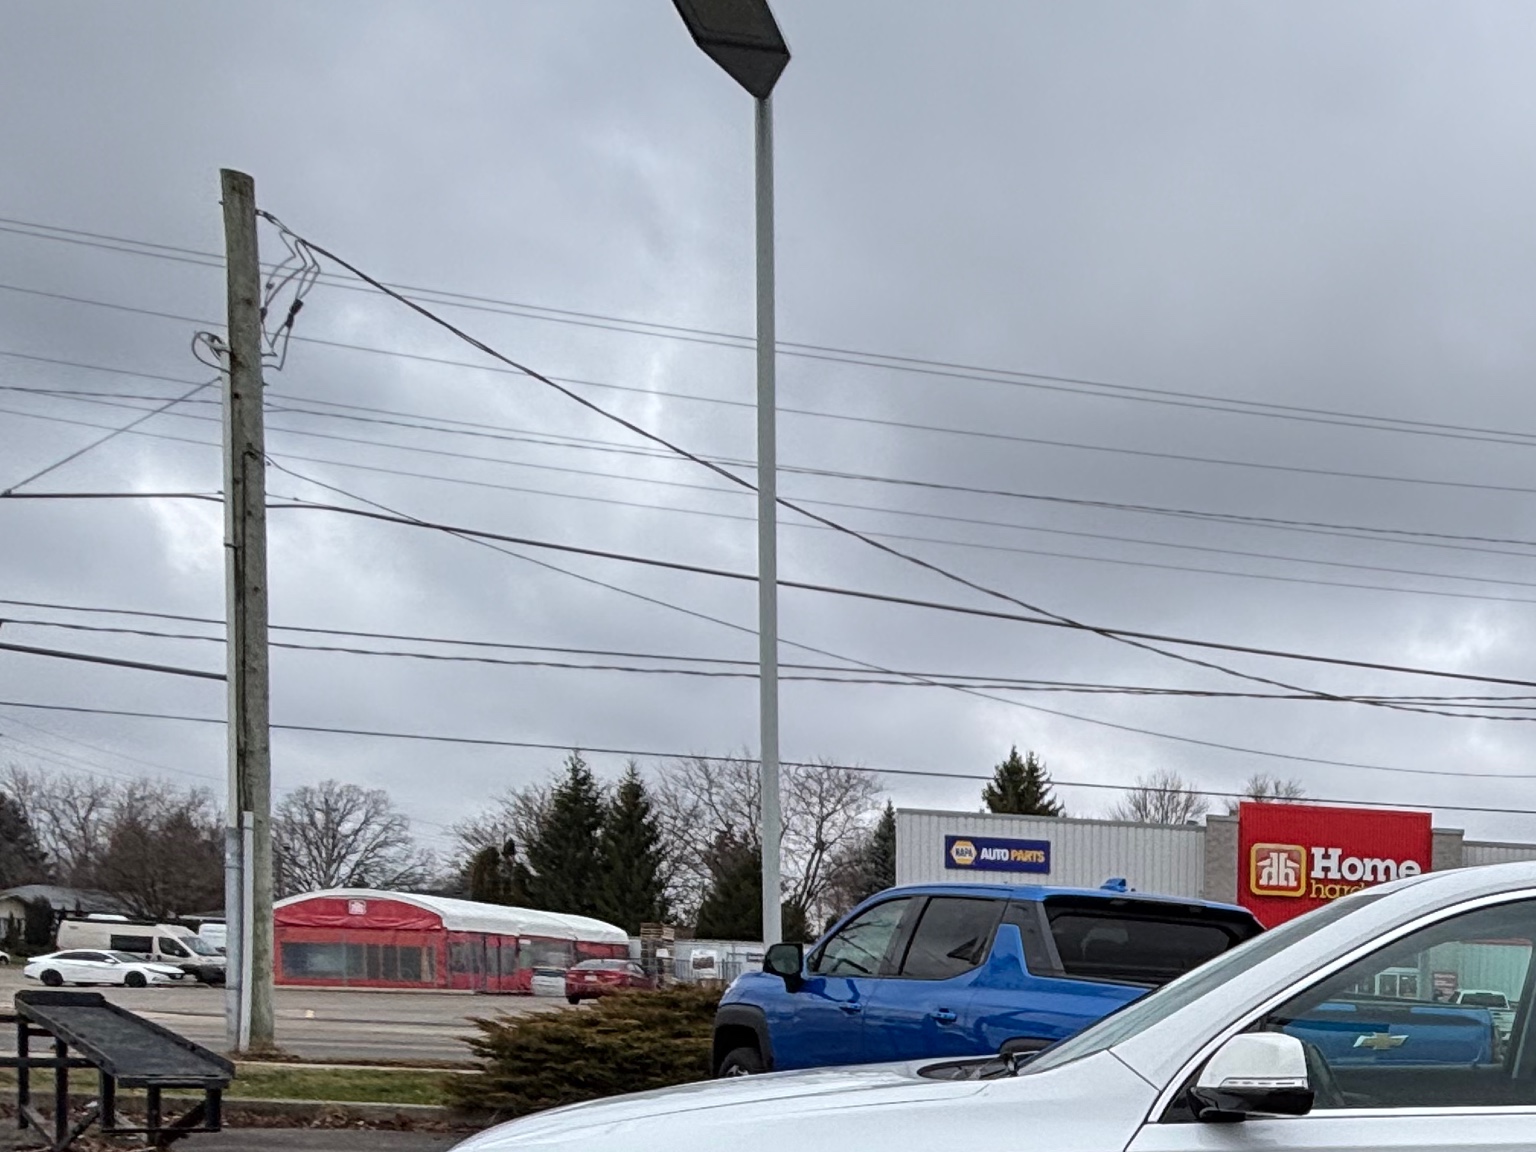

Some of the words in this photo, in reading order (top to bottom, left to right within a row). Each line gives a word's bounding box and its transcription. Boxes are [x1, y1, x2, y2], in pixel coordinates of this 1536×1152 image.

[955, 847, 973, 858] NAPA
[980, 847, 1009, 861] AUTO
[1010, 849, 1046, 863] PARTS
[1310, 846, 1421, 882] Home
